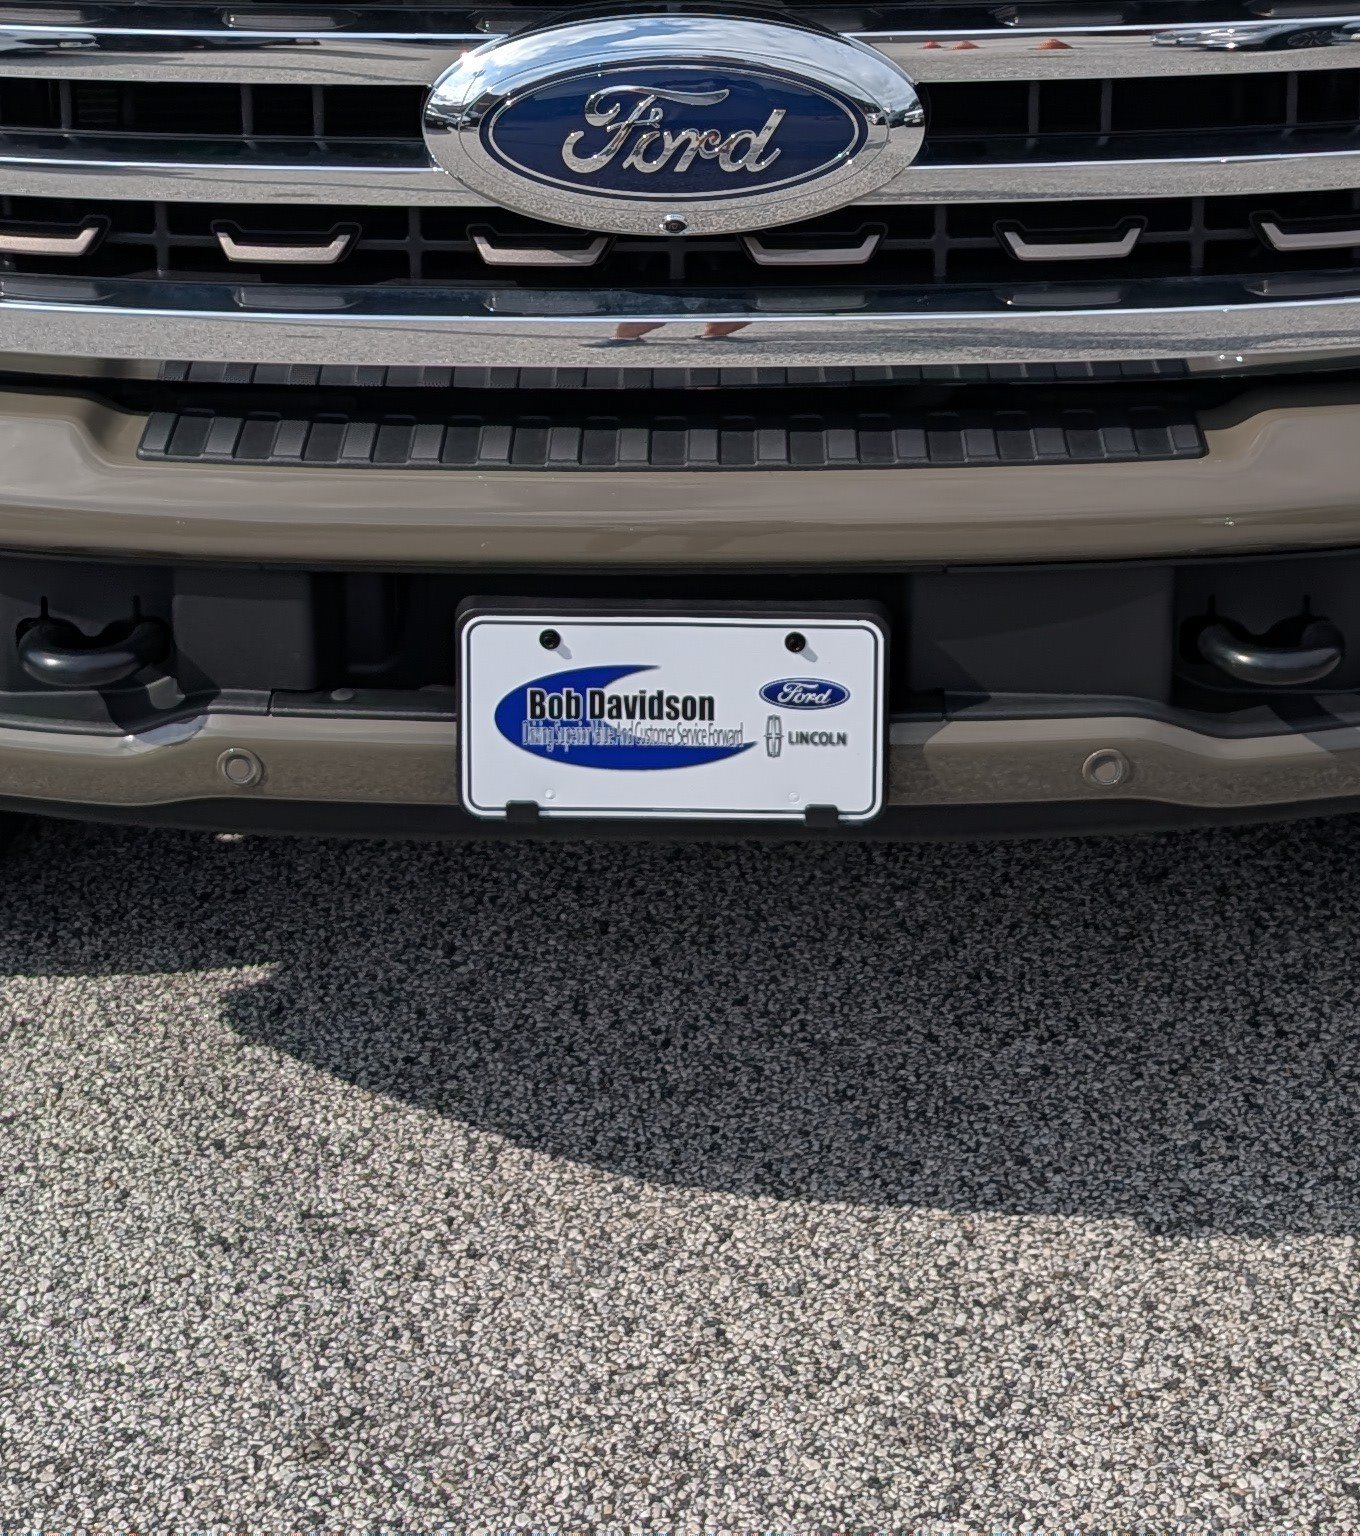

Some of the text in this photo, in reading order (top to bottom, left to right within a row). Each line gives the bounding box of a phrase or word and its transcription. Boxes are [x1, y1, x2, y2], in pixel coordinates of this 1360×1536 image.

[562, 84, 787, 174] Ford
[528, 688, 716, 721] Bob Davidson
[776, 681, 833, 704] Ford
[635, 721, 675, 745] Customer
[676, 721, 707, 745] Service
[708, 721, 744, 747] Forward
[787, 730, 848, 747] LINCOLN
